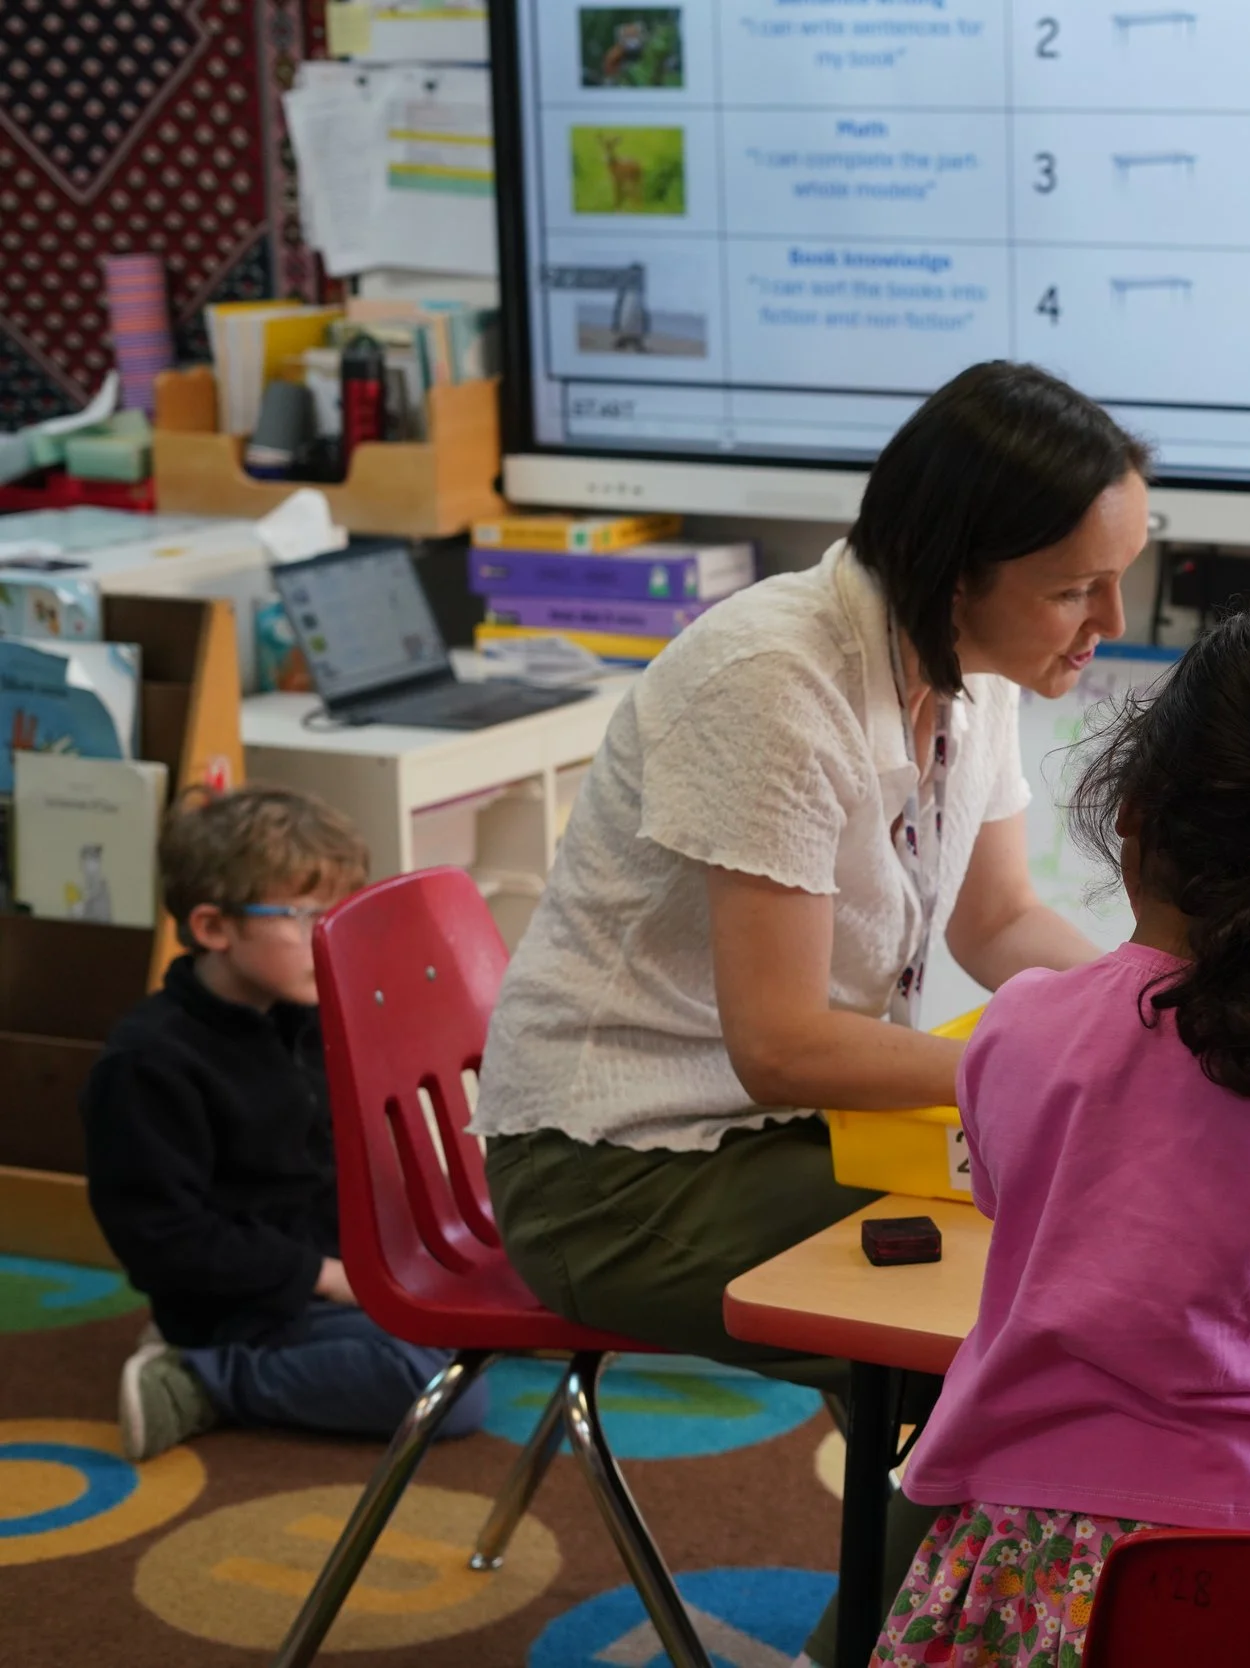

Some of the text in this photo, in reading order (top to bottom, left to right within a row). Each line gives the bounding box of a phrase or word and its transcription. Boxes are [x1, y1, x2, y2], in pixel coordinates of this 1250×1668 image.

[801, 19, 845, 36] write
[852, 19, 951, 36] sentences
[1034, 17, 1060, 59] 2
[836, 119, 889, 138] Math
[806, 151, 894, 172] complete
[901, 150, 931, 168] the
[1033, 151, 1057, 194] 3
[788, 248, 953, 273] Book knowledge
[811, 279, 846, 297] sort
[853, 279, 881, 298] the
[887, 281, 944, 299] books
[951, 283, 988, 301] into
[1035, 285, 1061, 325] 4
[758, 307, 818, 325] fiction
[826, 311, 859, 329] and
